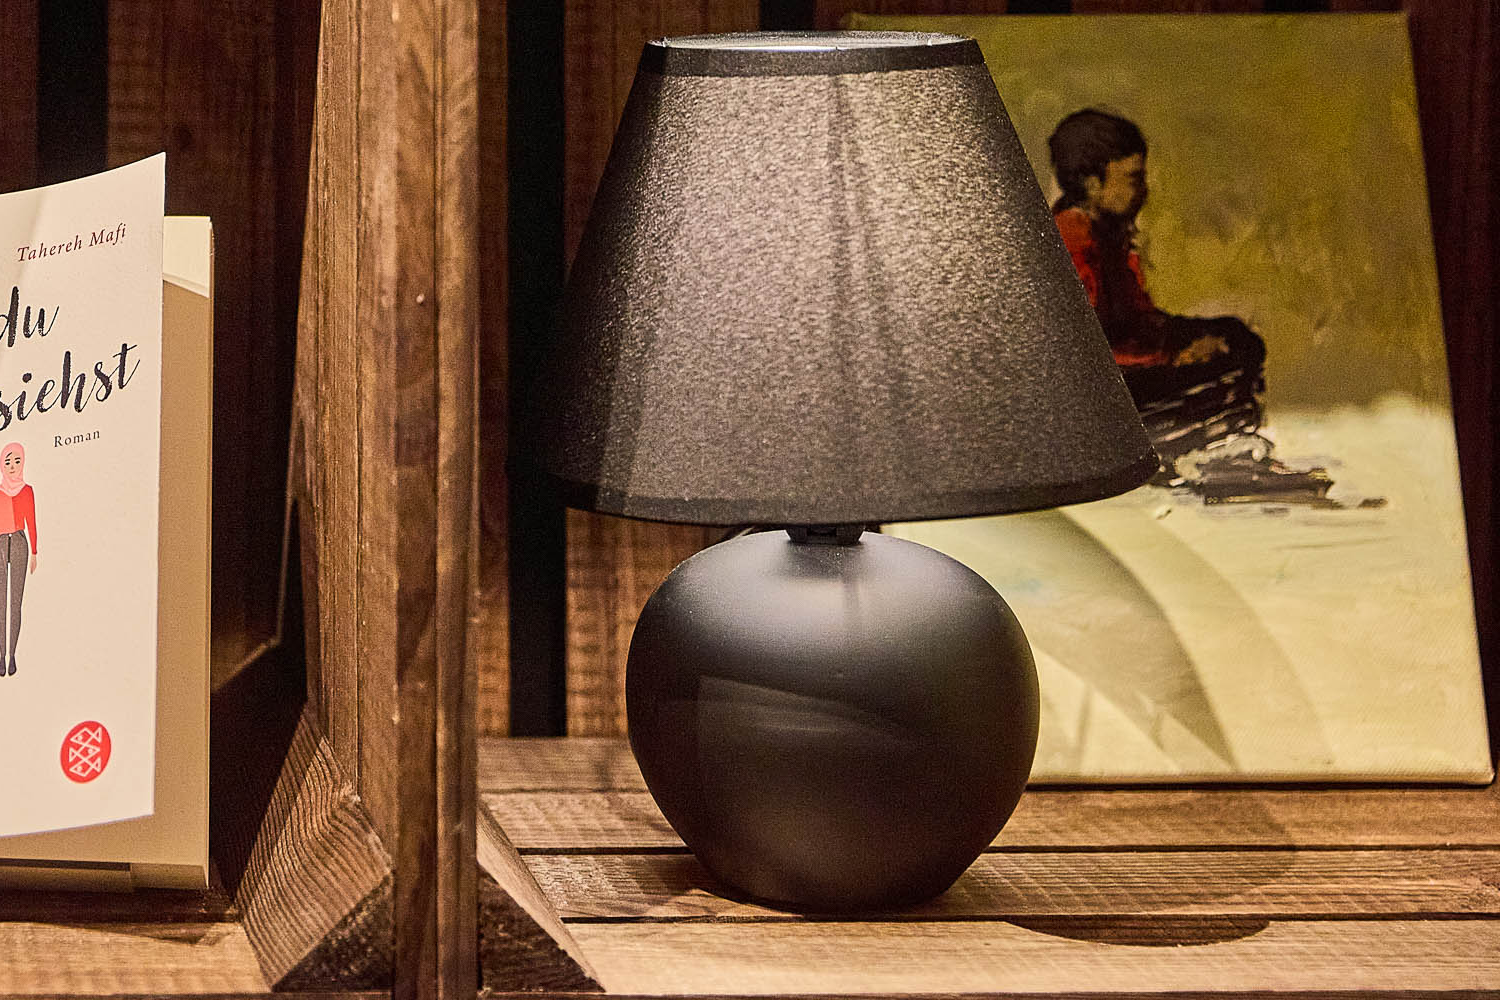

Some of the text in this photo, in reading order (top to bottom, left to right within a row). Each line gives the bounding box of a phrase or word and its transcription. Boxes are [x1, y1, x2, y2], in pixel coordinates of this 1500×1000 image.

[16, 223, 127, 263] Tahereh Mafi
[53, 428, 101, 448] Roman
